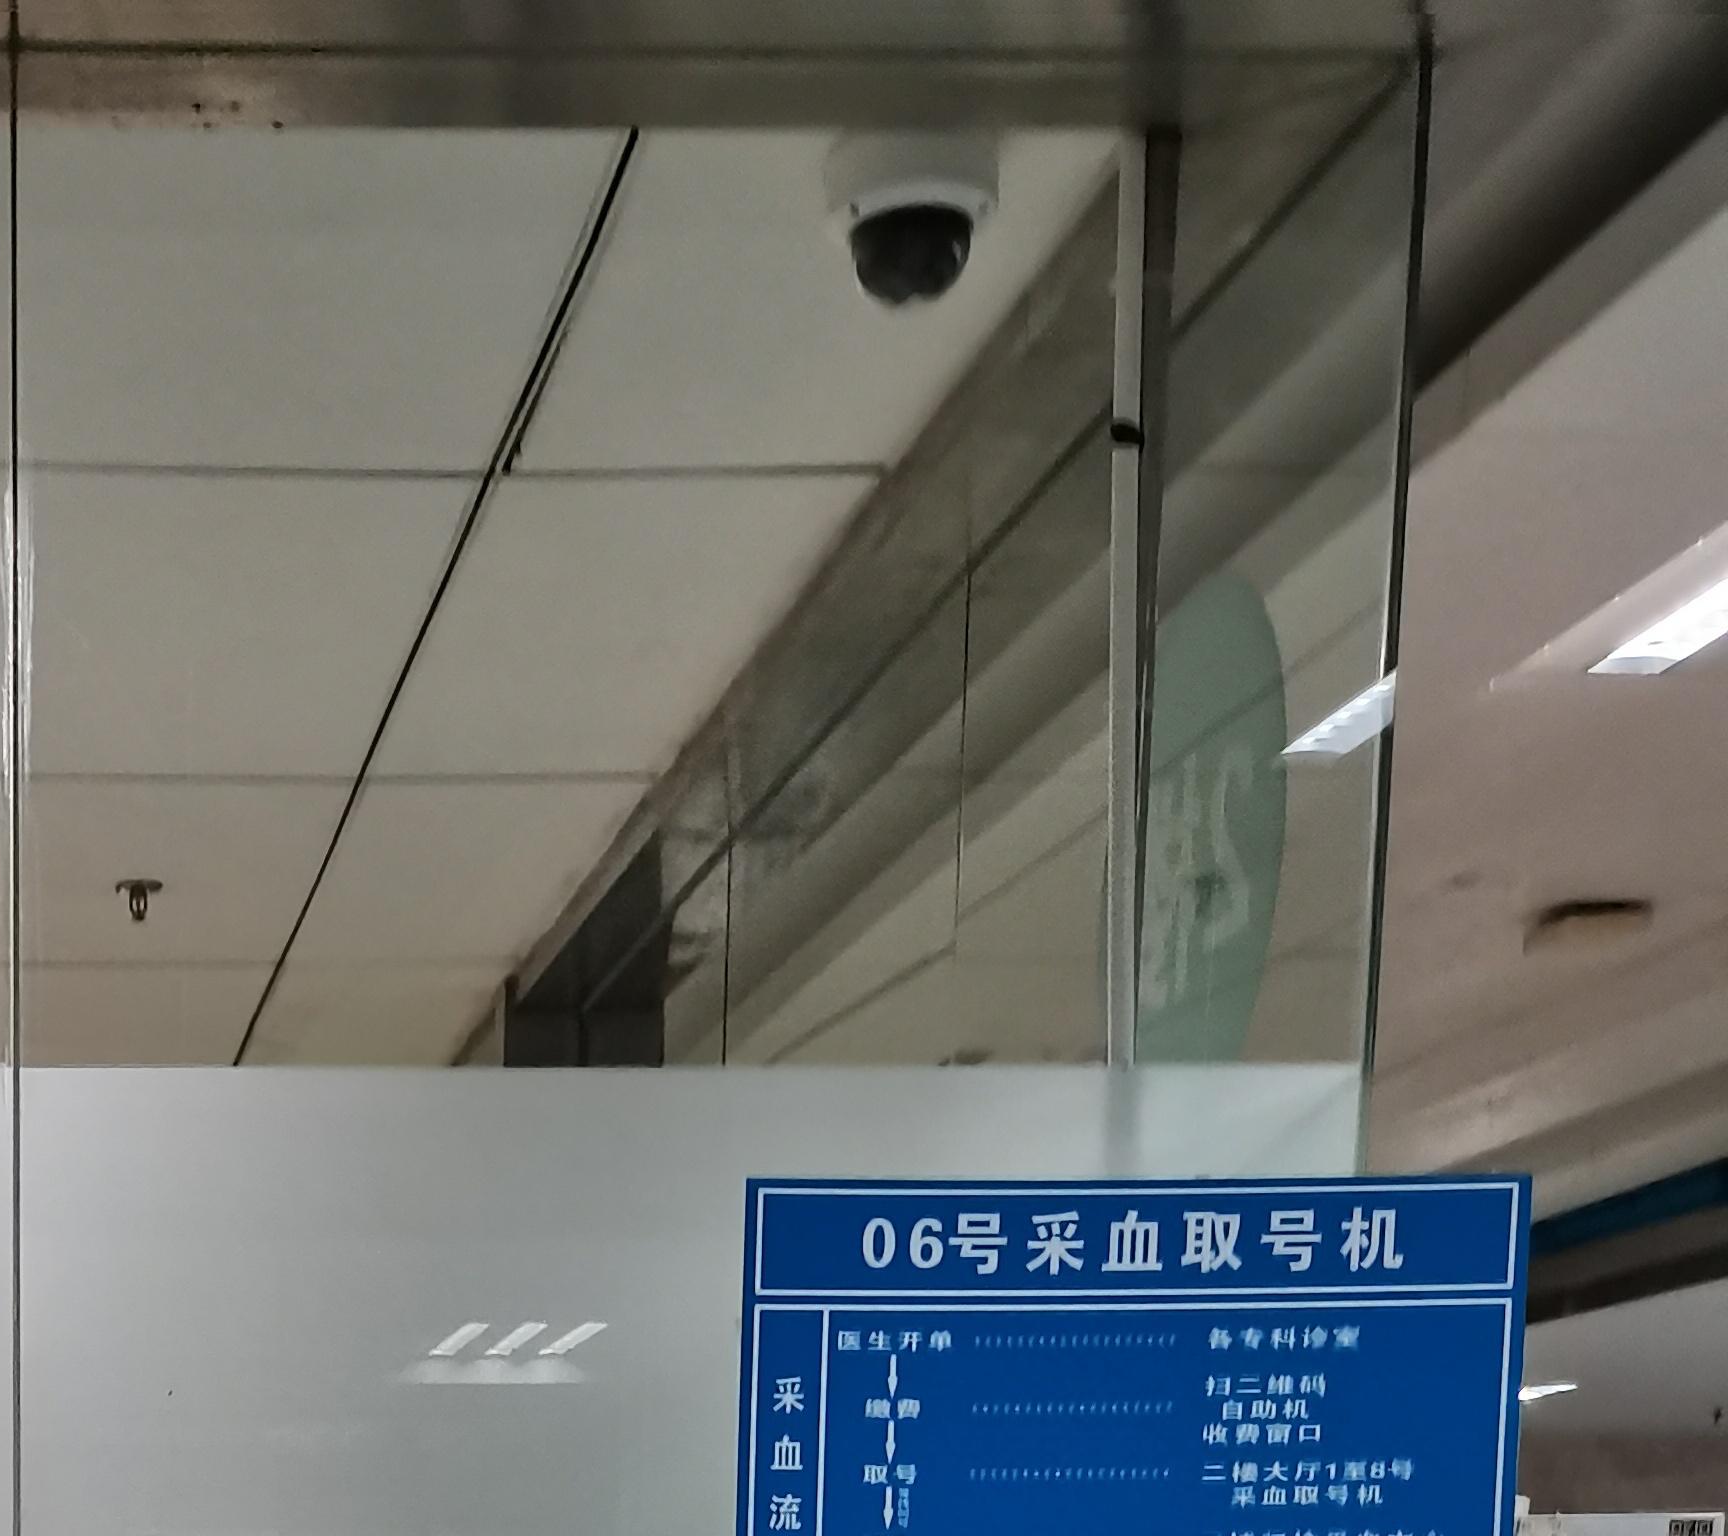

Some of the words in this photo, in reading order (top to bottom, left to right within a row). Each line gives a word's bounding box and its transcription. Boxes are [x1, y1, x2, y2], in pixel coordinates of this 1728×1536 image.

[863, 1207, 1403, 1275] 06号采血取号机
[838, 1331, 951, 1352] 医生开单
[1209, 1326, 1360, 1349] 各专科诊室
[1206, 1373, 1325, 1397] 扫二维码
[1223, 1399, 1308, 1420] 自助机
[1203, 1423, 1320, 1444] 收费窗口
[864, 1463, 916, 1484] 取号
[1202, 1459, 1412, 1483] 二楼大厅1至8号
[1232, 1485, 1383, 1507] 采血取号机
